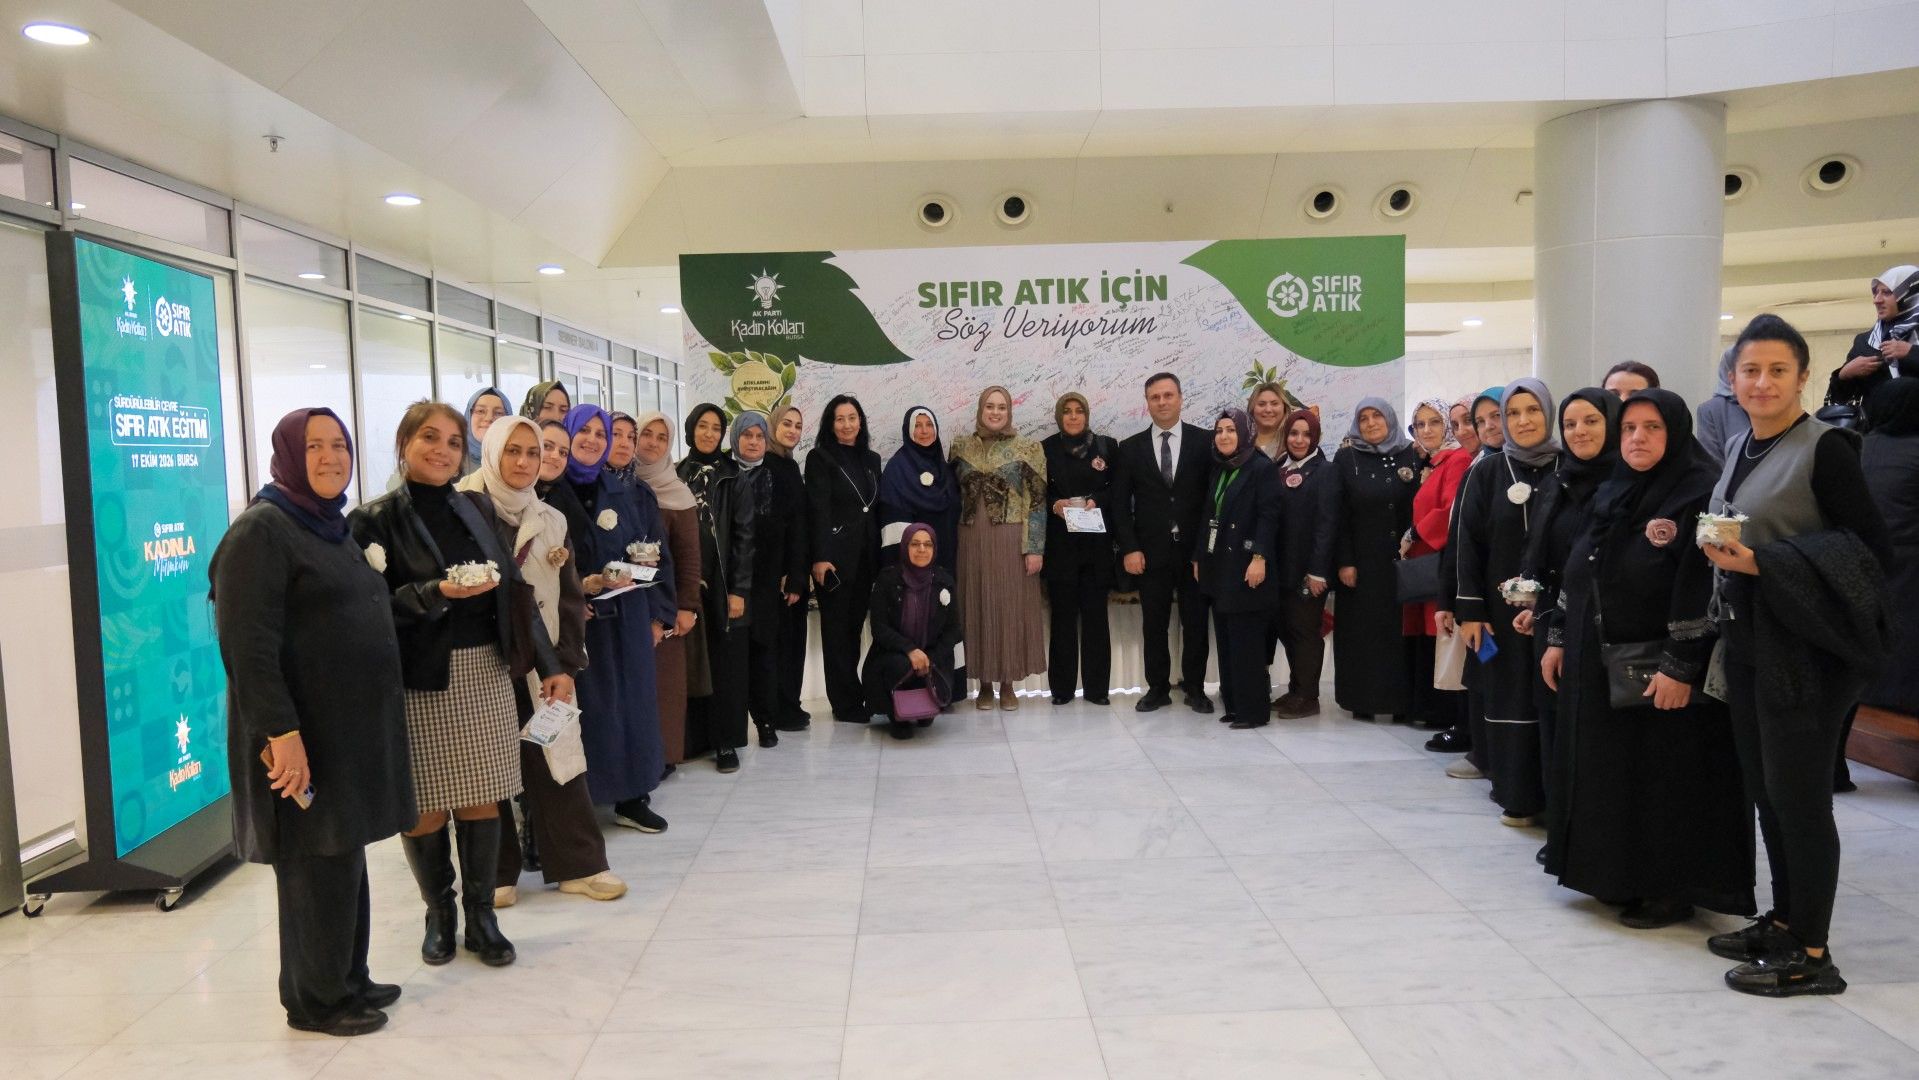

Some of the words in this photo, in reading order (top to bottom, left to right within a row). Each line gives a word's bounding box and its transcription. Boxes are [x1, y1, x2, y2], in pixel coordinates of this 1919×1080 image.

[918, 281, 1003, 308] SIFIR
[1014, 278, 1090, 306] ATIK
[1101, 269, 1168, 308] İÇİN
[1312, 275, 1362, 293] SIFIR
[1312, 293, 1362, 312] ATIK
[171, 303, 191, 321] SIFIR
[173, 320, 192, 338] ATIK
[731, 319, 766, 342] Kadın
[767, 318, 805, 336] Kolları
[937, 307, 992, 352] Söz
[1003, 306, 1157, 349] Veriyorum
[140, 451, 158, 468] EKİM
[176, 453, 199, 467] BURSA
